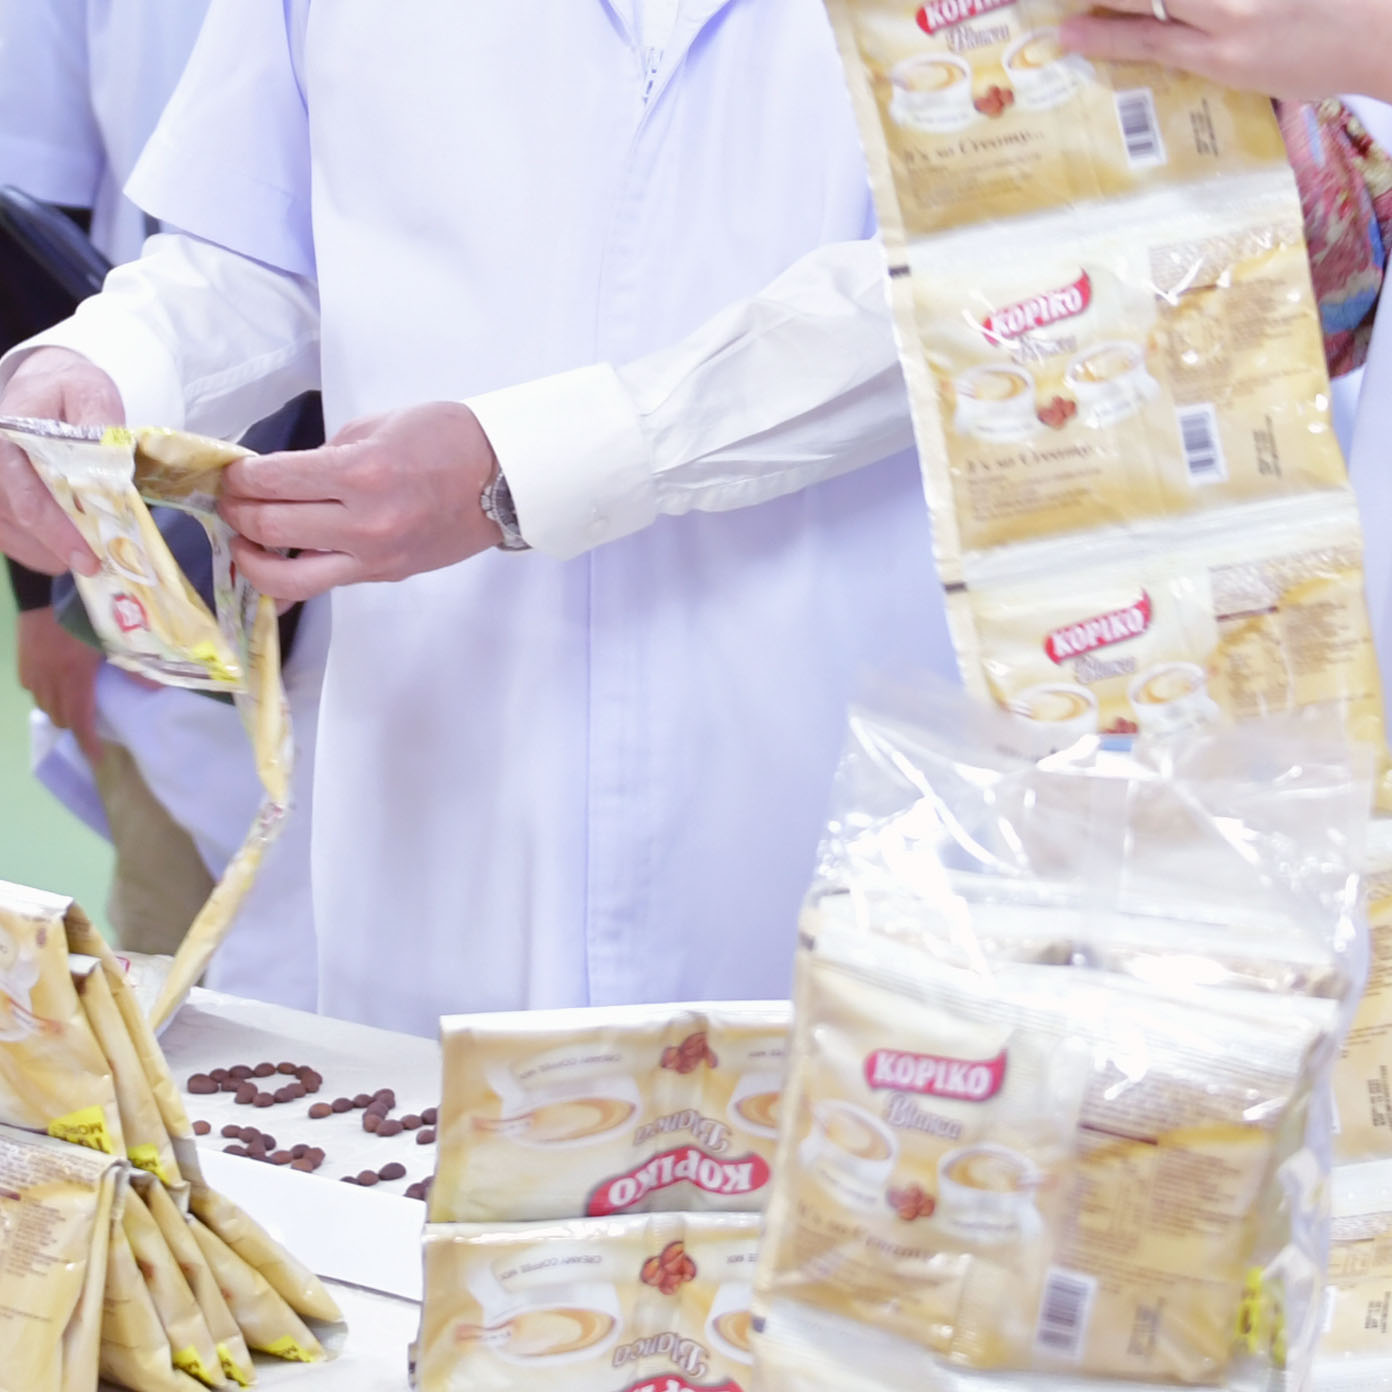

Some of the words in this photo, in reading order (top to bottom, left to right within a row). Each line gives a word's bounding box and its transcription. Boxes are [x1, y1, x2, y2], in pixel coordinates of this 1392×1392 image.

[991, 288, 1083, 338] KOPIKO
[1052, 608, 1145, 657] KOPIKO
[873, 1051, 990, 1095] KOPIKO
[608, 1150, 753, 1206] KOPIKO
[611, 1331, 710, 1378] Blanca
